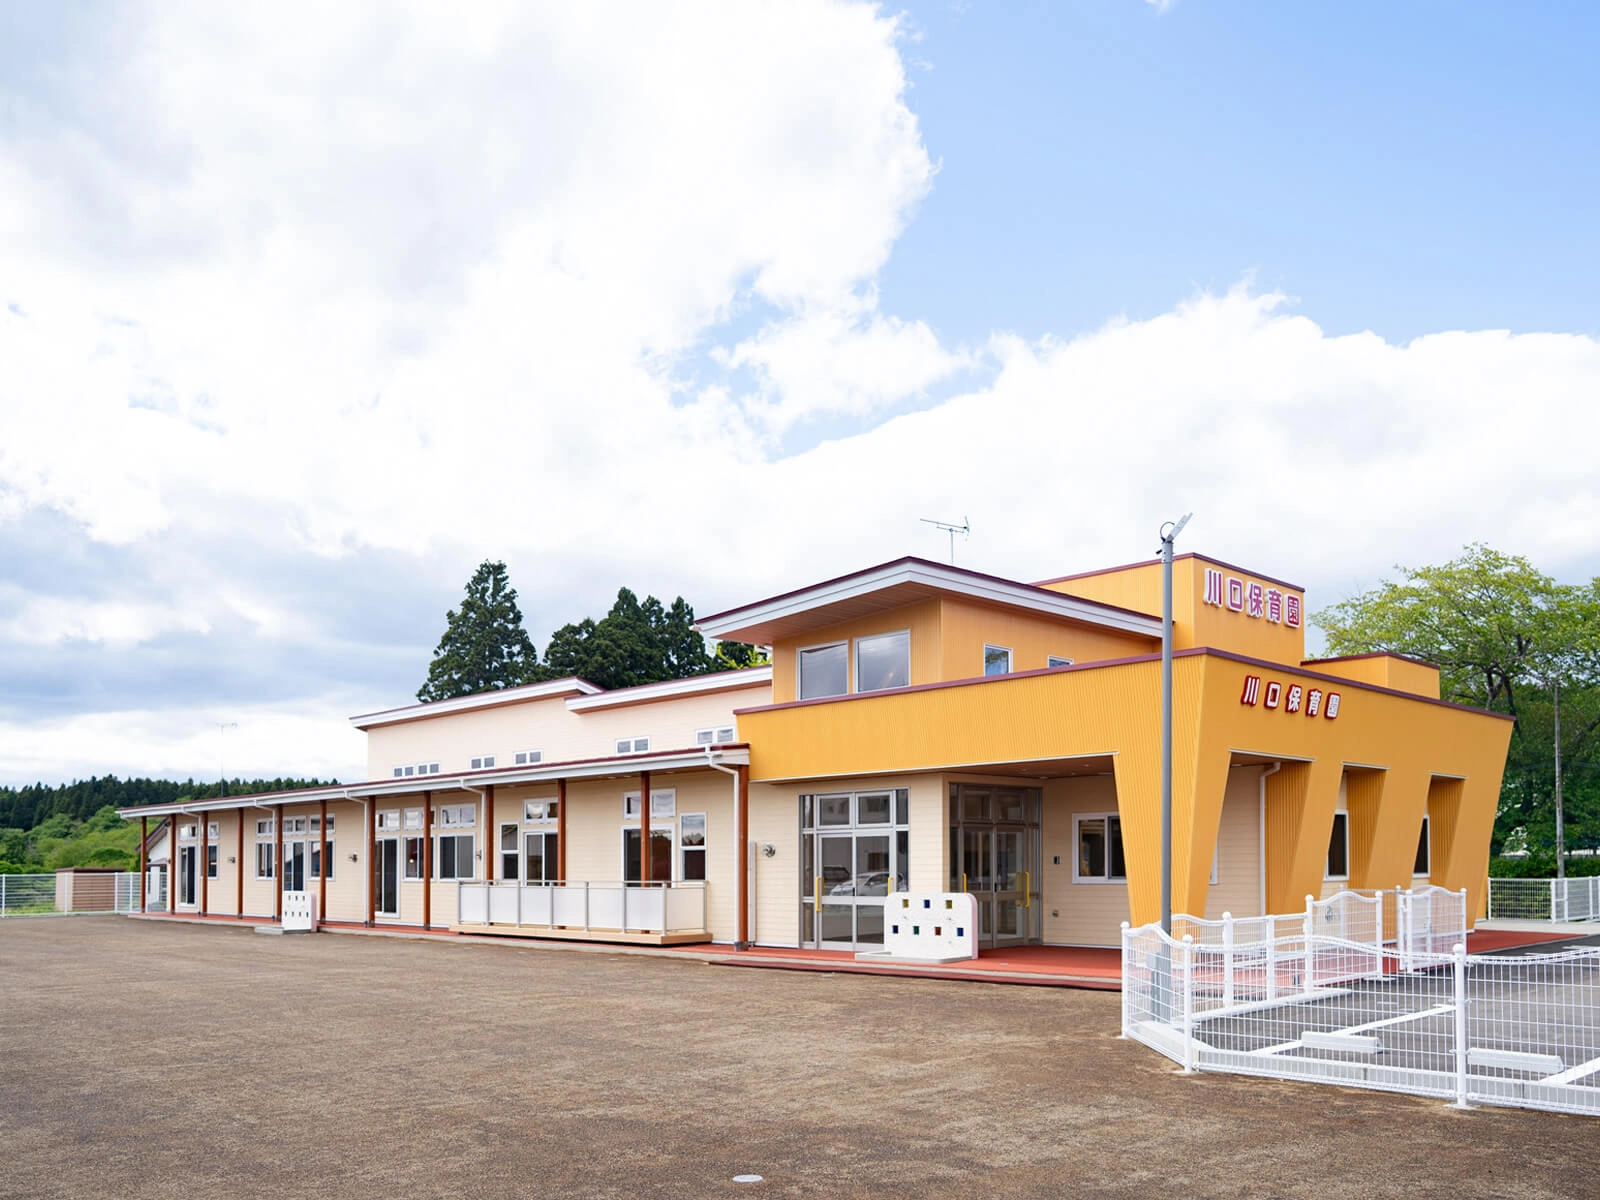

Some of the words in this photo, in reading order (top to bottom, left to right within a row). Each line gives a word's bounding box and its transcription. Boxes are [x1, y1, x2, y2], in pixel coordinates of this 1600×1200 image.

[1204, 568, 1300, 628] 川口保育園
[1241, 675, 1341, 719] 川口保育園
